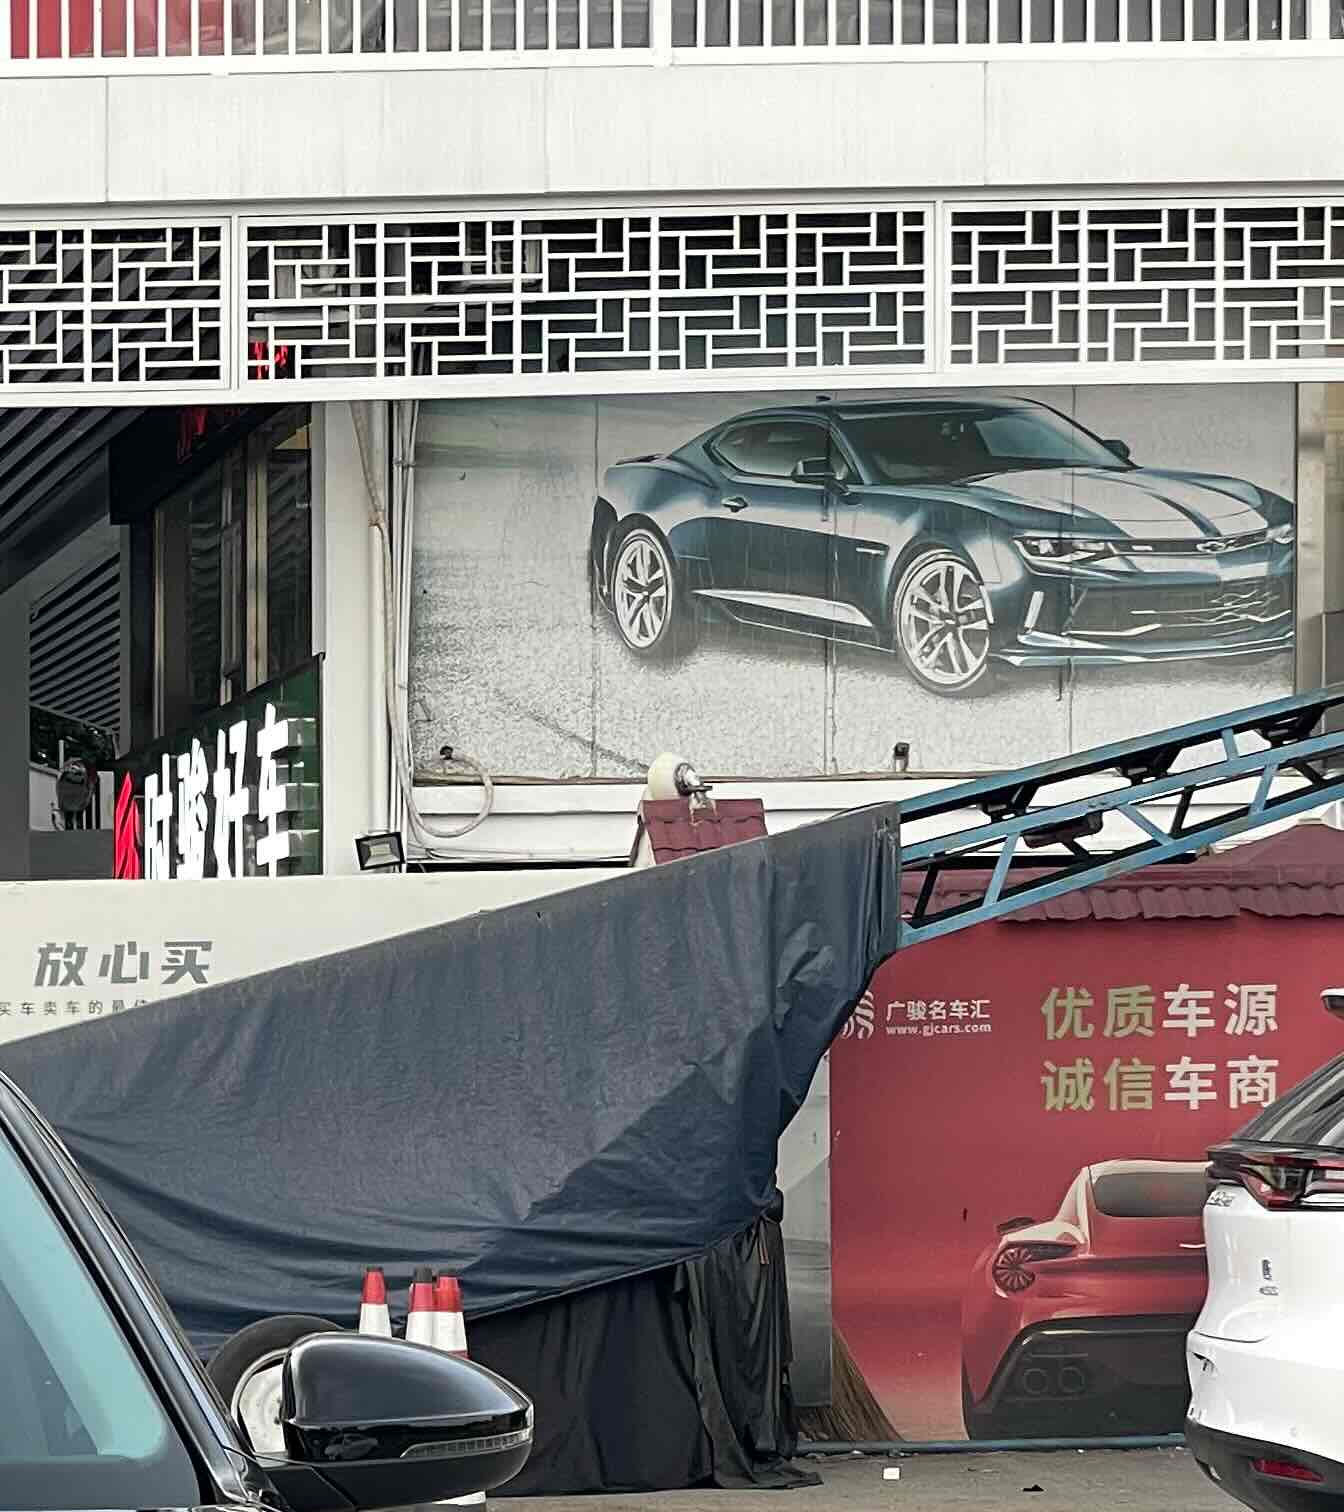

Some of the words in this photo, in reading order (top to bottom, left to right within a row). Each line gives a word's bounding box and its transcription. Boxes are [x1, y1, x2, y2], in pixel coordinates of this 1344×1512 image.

[34, 939, 214, 988] 放心买
[886, 1000, 991, 1022] 广骏名车汇
[1040, 983, 1279, 1041] 优质车源
[1040, 1054, 1280, 1111] 诚信车商
